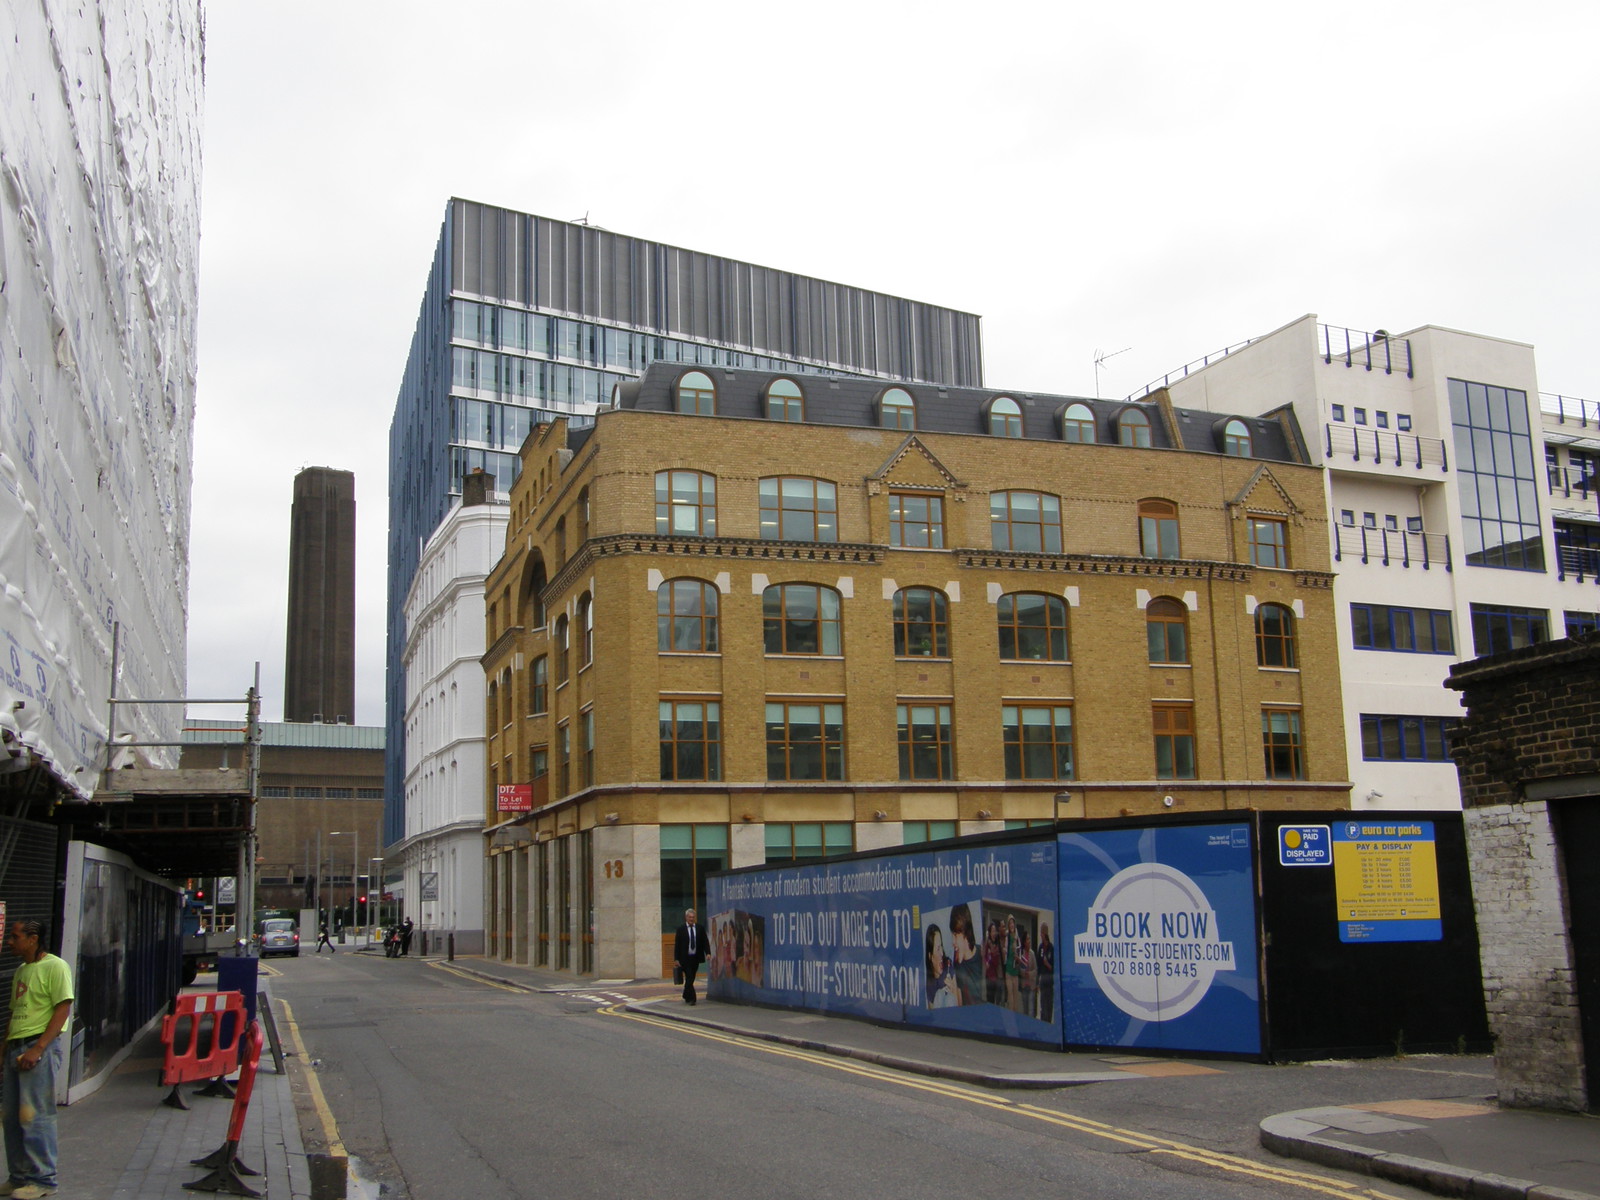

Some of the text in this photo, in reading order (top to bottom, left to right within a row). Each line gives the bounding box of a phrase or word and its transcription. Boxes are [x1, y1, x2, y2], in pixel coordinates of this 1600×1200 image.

[500, 786, 516, 794] DTZ
[1362, 824, 1422, 837] euro car parks
[604, 860, 623, 878] 13
[722, 880, 726, 896] A
[726, 878, 750, 899] fantastic
[752, 876, 772, 898] choice
[774, 874, 782, 896] of
[784, 872, 810, 896] modern
[812, 870, 840, 894] student
[842, 862, 902, 892] accommodation
[906, 858, 962, 895] throughout
[966, 853, 1009, 886] London
[772, 913, 785, 945] TO
[790, 912, 814, 945] FIND
[818, 912, 837, 946] OUT
[841, 910, 870, 947] MORE
[872, 909, 888, 948] GO
[893, 908, 911, 949] TO
[1096, 912, 1208, 938] BOOK NOW
[1078, 942, 1230, 961] WWW.UNITE-STUDENTS.COM
[1104, 961, 1197, 977] 020 8808 5445
[770, 960, 920, 1006] WWW.UNITE-STUDENTS.COM
